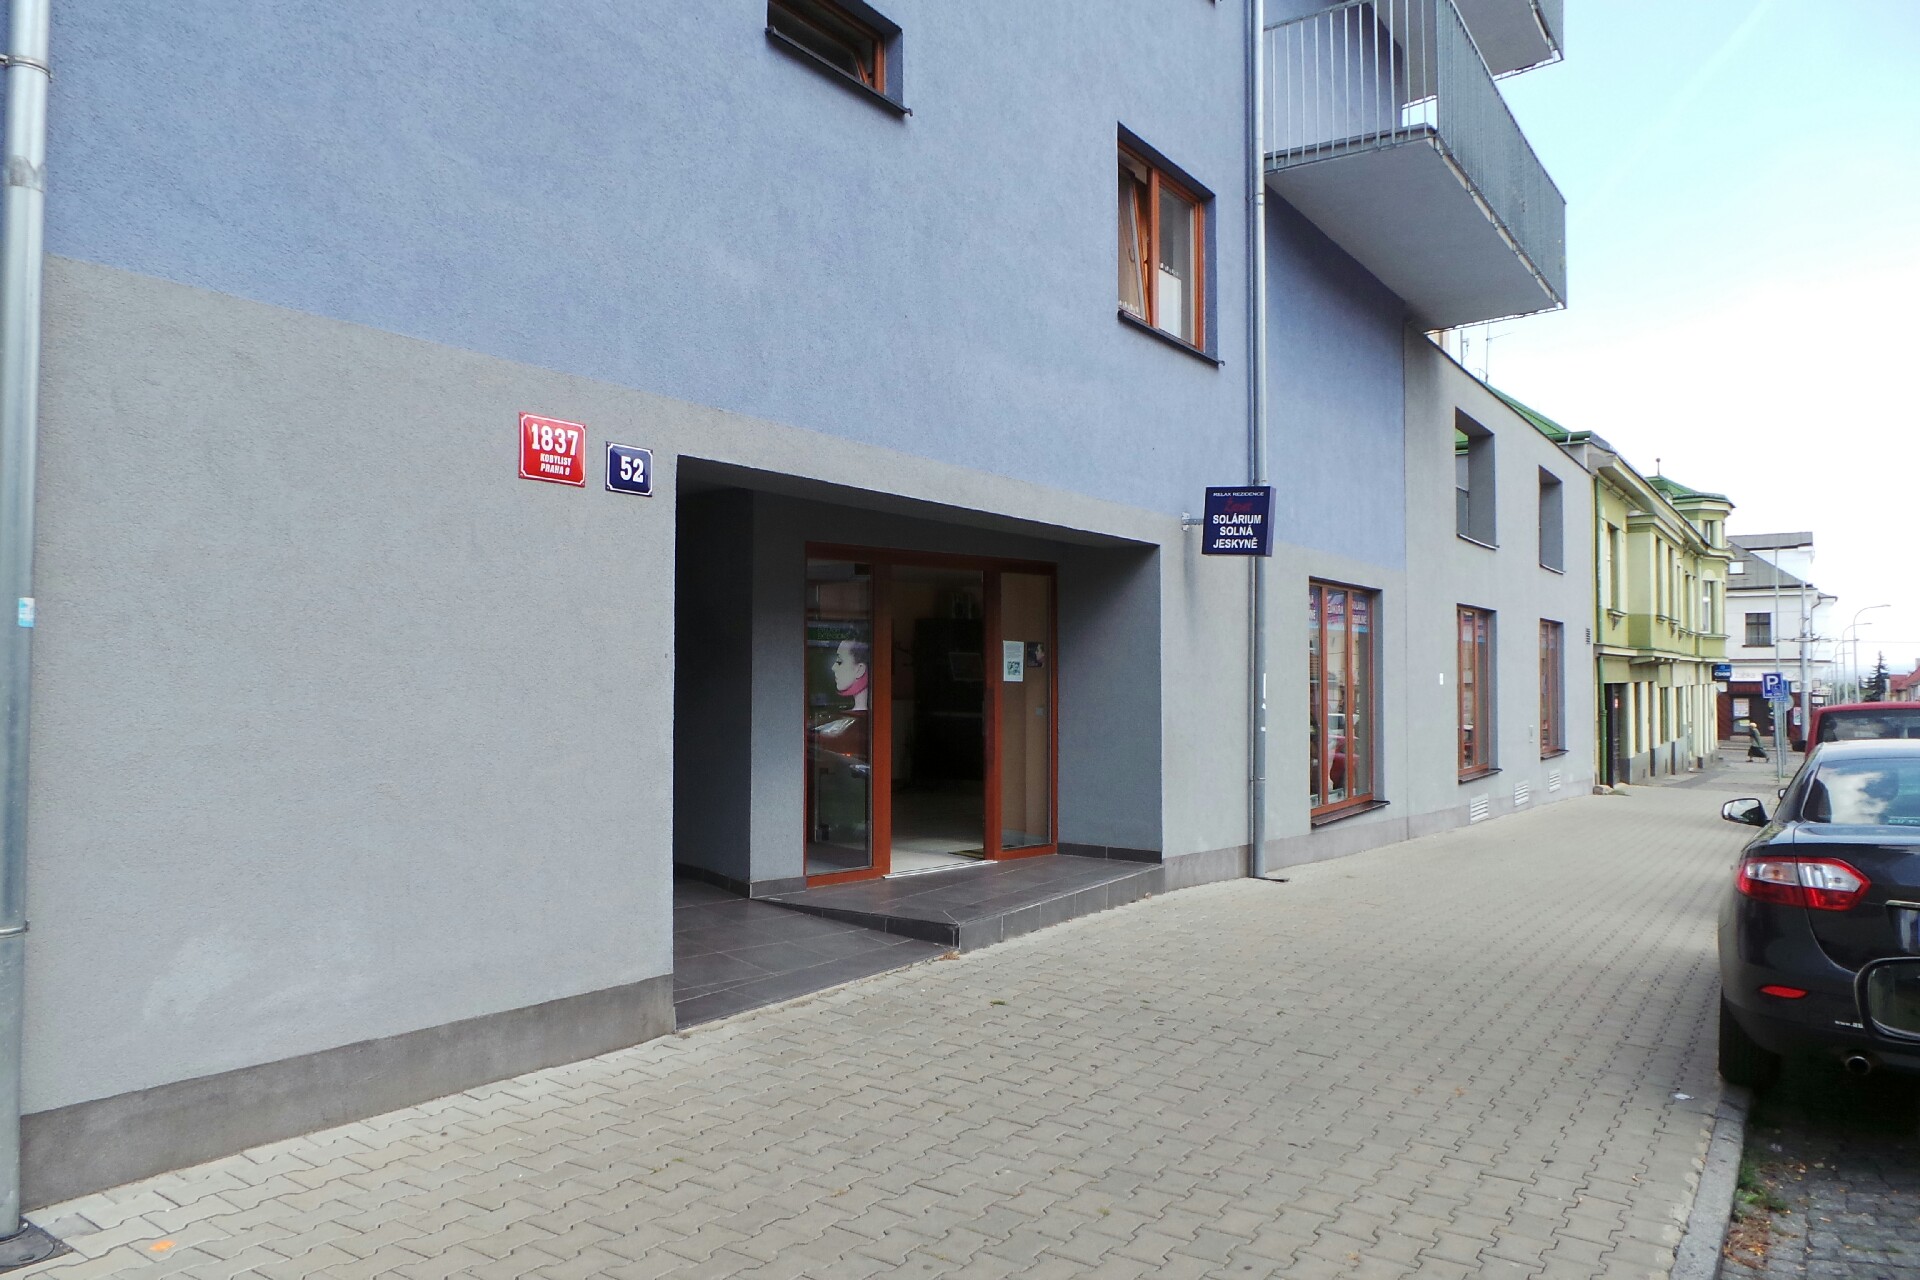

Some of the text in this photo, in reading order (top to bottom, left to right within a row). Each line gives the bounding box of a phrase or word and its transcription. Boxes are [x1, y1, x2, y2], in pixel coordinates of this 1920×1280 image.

[531, 423, 578, 456] 1837
[540, 453, 572, 466] KOBYLISY
[540, 463, 570, 476] PRAHA 8
[620, 456, 644, 483] 52
[1213, 513, 1262, 524] SOLÁRIUM
[1220, 525, 1253, 536] SOLNÁ
[1213, 537, 1258, 548] JESKYNĚ
[1766, 676, 1778, 690] P
